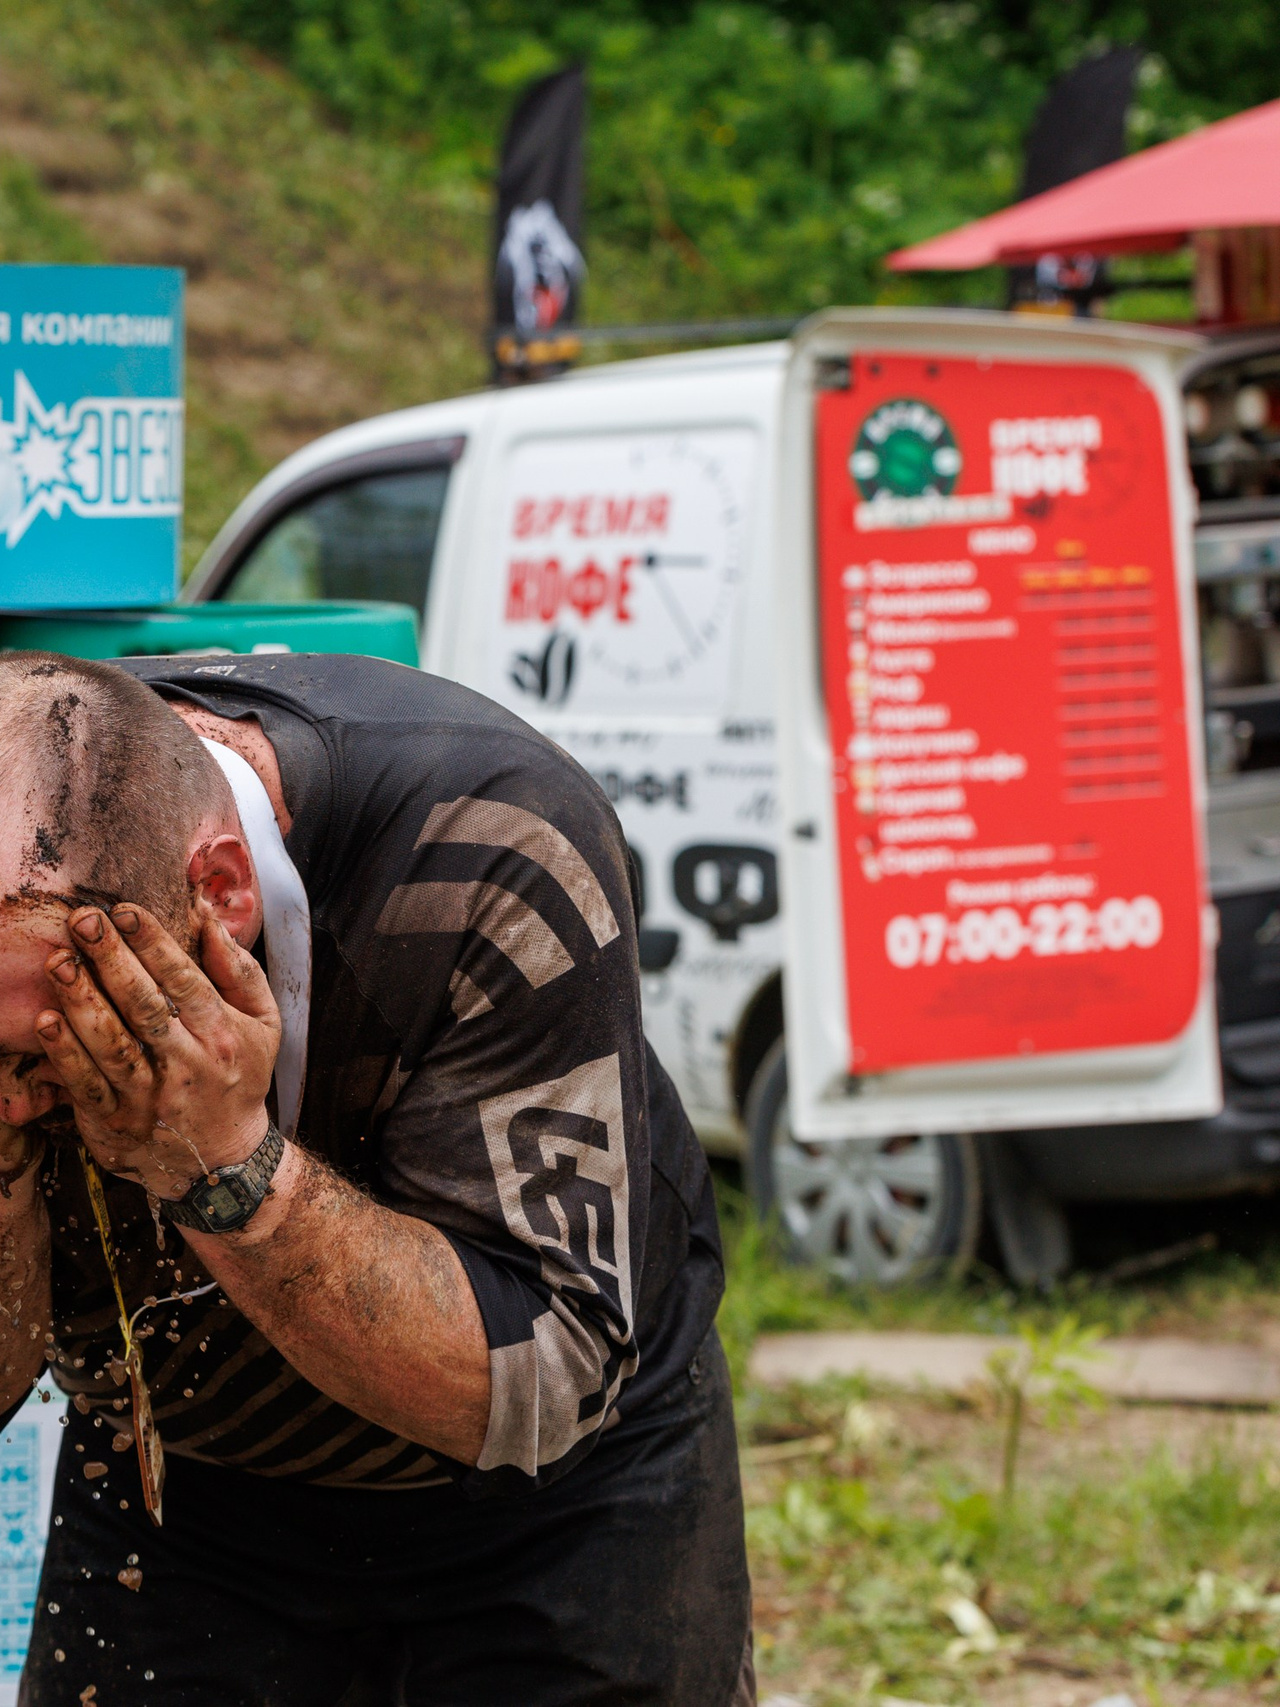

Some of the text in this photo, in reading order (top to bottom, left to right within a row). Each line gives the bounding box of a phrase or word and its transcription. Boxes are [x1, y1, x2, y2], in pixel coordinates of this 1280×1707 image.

[22, 314, 172, 345] компании
[512, 495, 671, 539] ВРЕМЯ
[506, 554, 634, 623] КОФЕ
[885, 895, 1163, 967] 07:00-22:00
